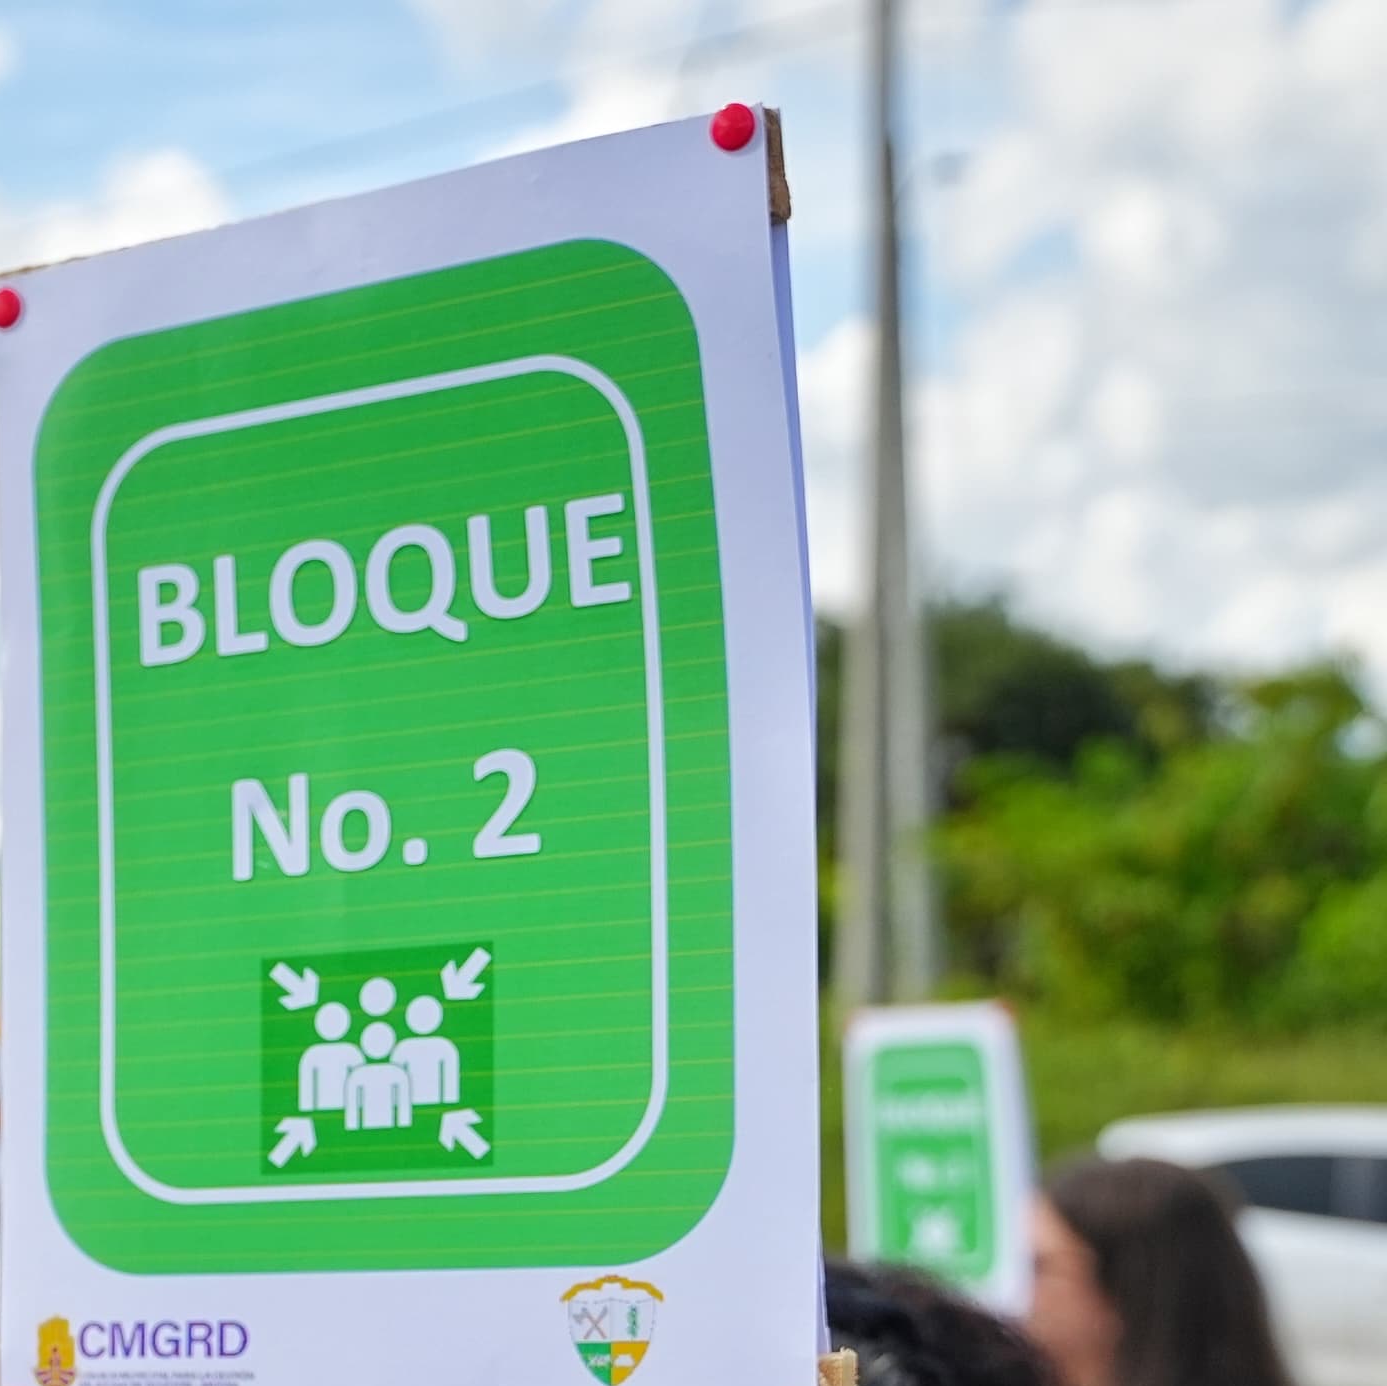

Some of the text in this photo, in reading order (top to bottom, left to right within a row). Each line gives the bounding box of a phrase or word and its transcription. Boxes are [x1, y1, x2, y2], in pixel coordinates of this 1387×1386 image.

[137, 493, 632, 667] BLOQUE
[231, 748, 542, 881] No. 2
[79, 1320, 250, 1359] CMGRD
